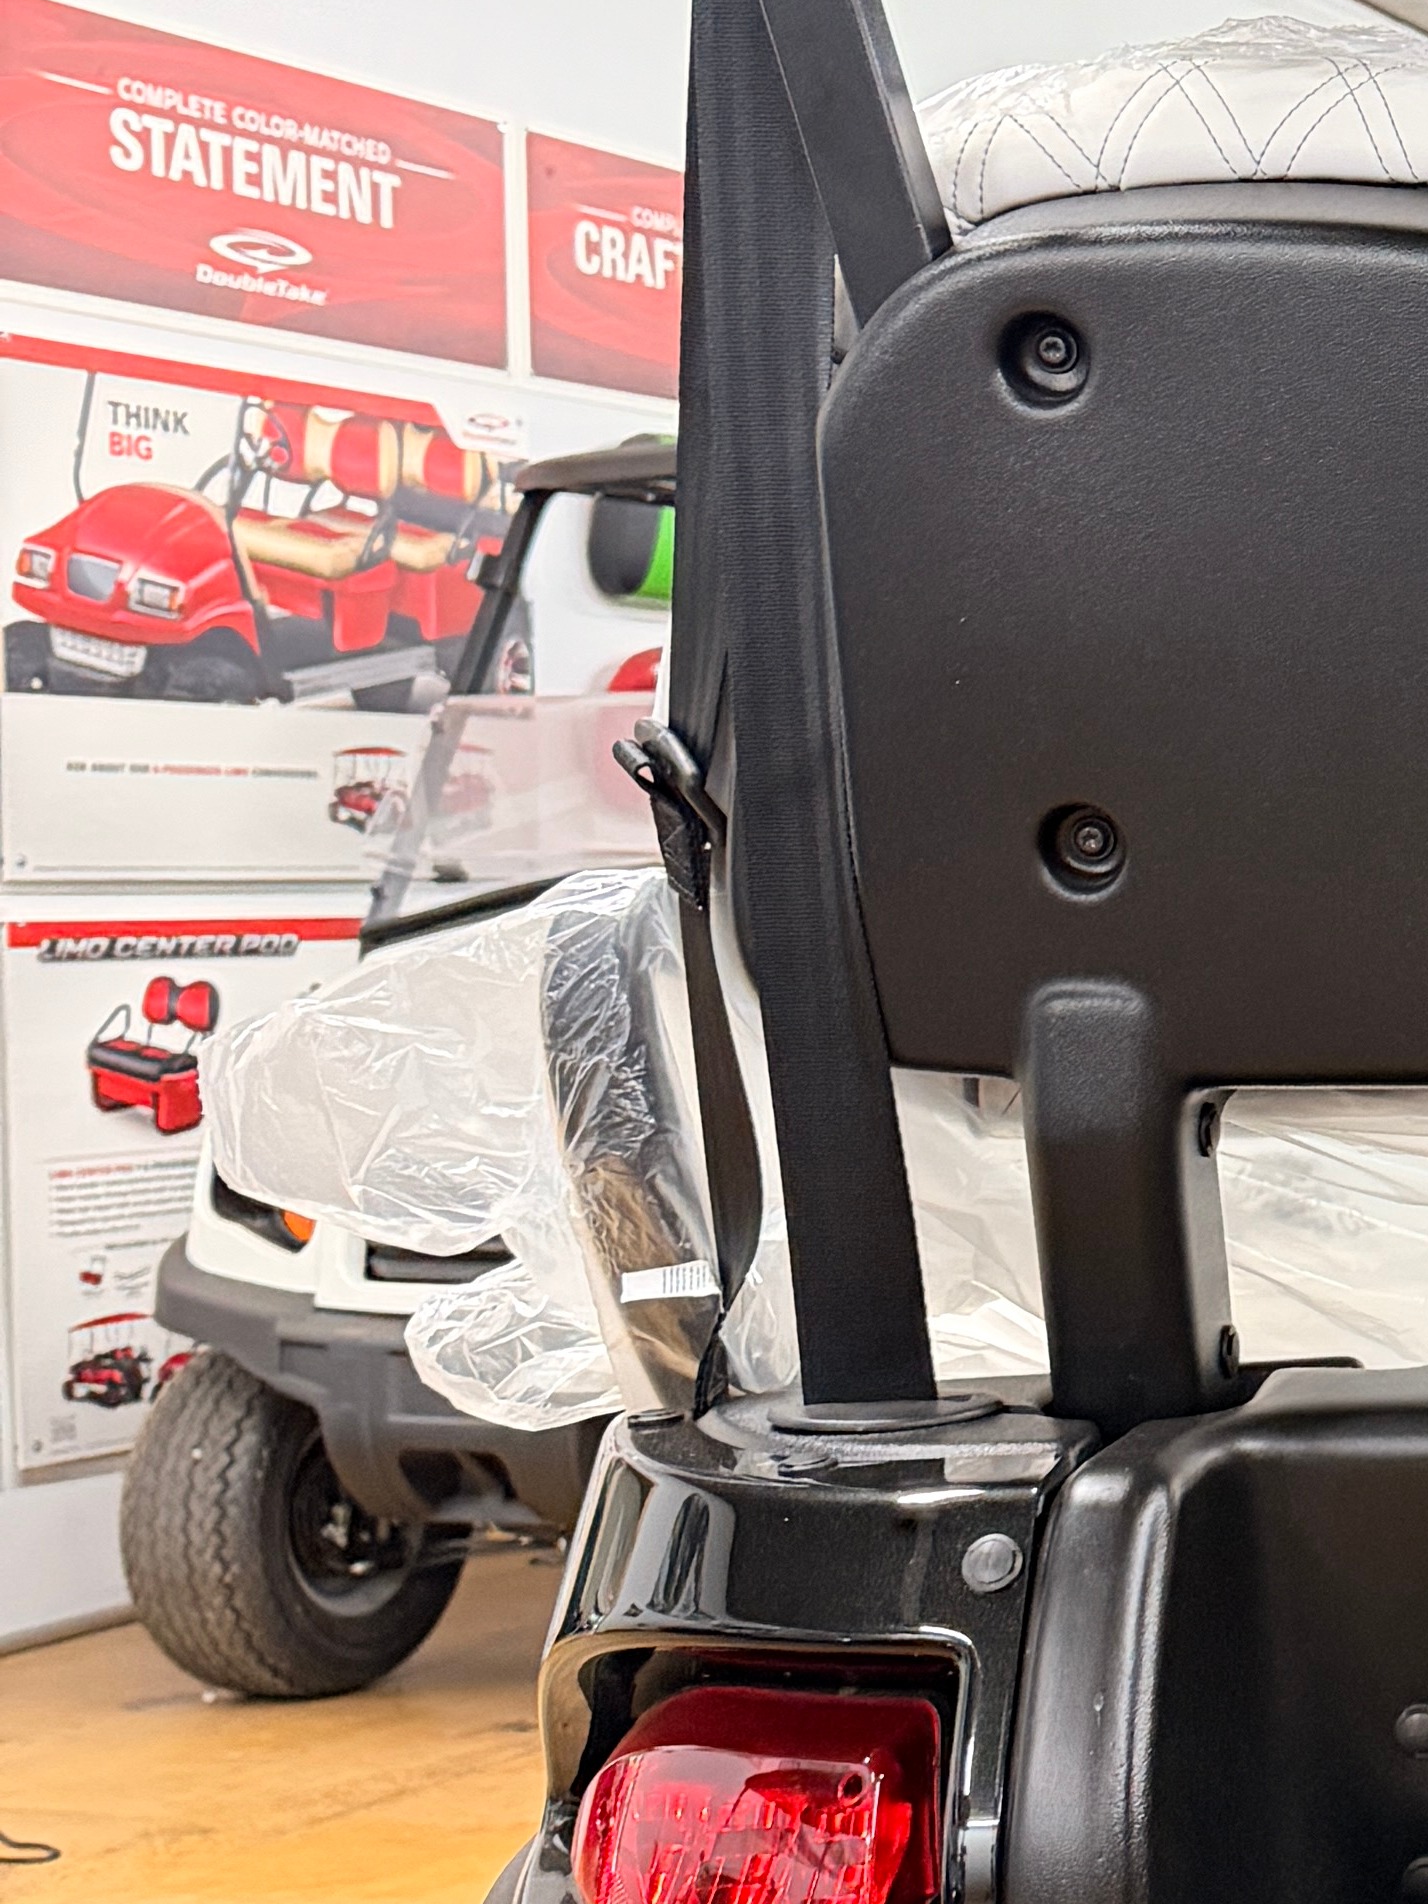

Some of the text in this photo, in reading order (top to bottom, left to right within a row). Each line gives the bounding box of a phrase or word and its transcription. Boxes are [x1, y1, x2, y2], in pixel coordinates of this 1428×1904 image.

[117, 77, 391, 164] COMPLETE COLOR-MATCHED
[109, 107, 401, 228] STATEMENT
[196, 263, 327, 306] DoubleTake
[108, 400, 190, 435] THINK
[109, 432, 153, 460] BIG
[39, 932, 301, 962] LIMO CENTER POD
